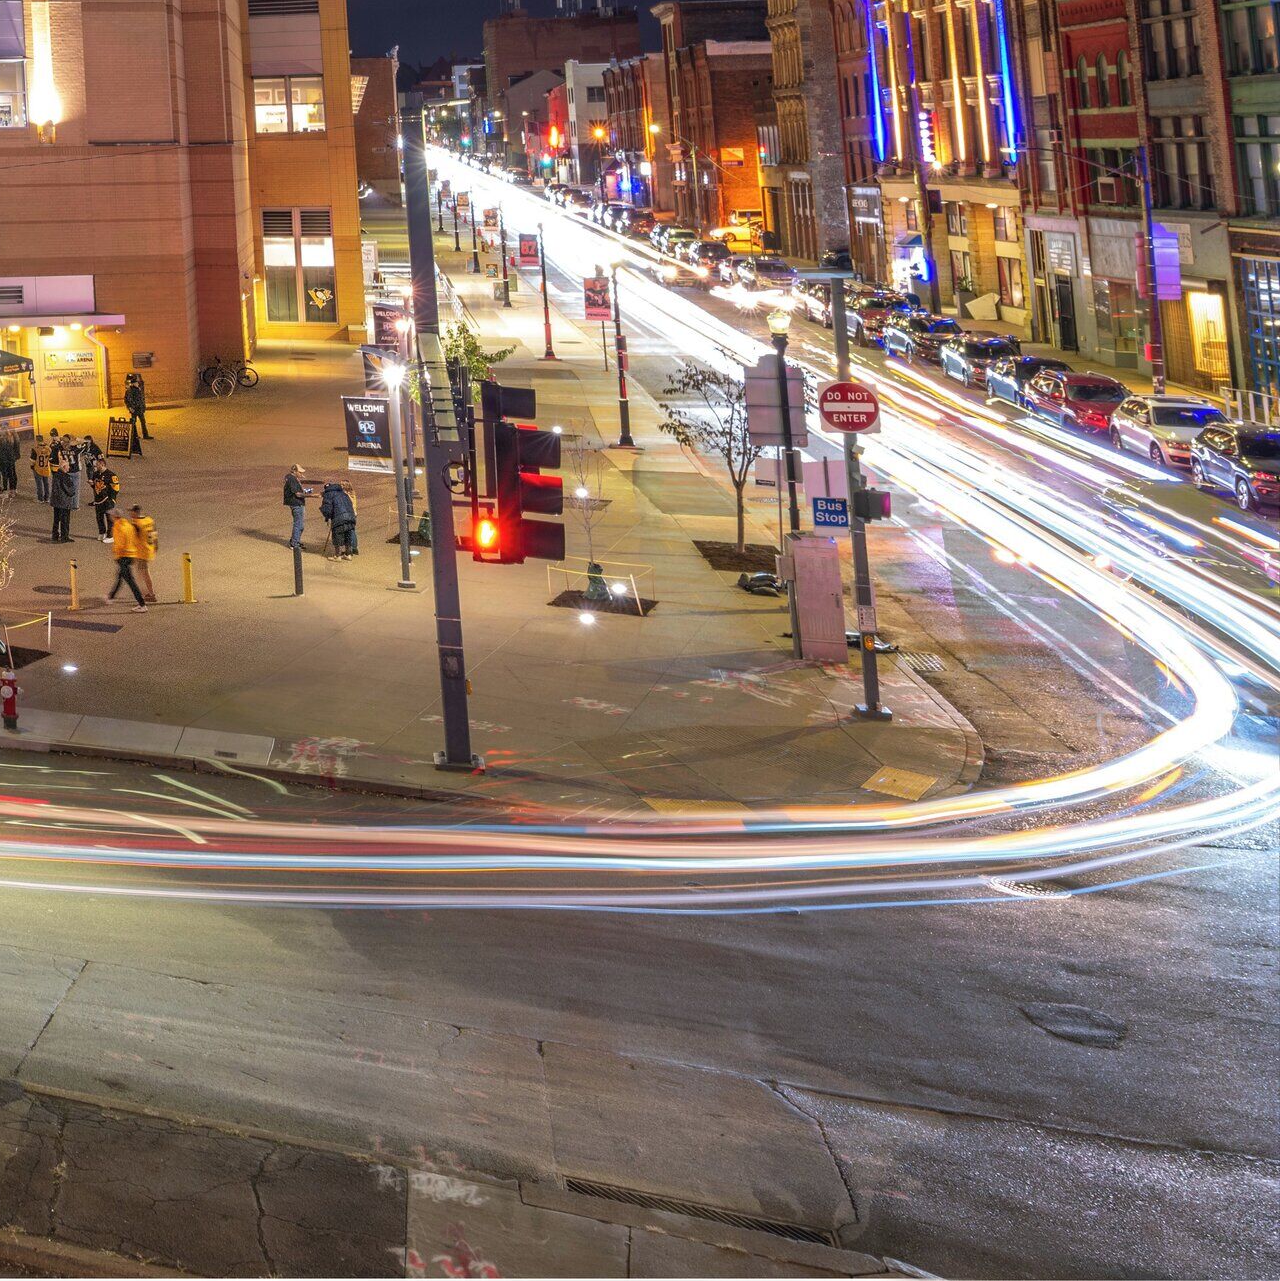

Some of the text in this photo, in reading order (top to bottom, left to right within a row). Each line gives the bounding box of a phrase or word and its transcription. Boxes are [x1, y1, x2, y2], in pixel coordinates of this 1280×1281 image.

[826, 392, 869, 400] DO NOT
[347, 403, 385, 413] WELCOME
[833, 414, 867, 422] ENTER
[356, 441, 382, 450] ARENA
[817, 500, 843, 510] Bus
[815, 512, 847, 524] Stop
